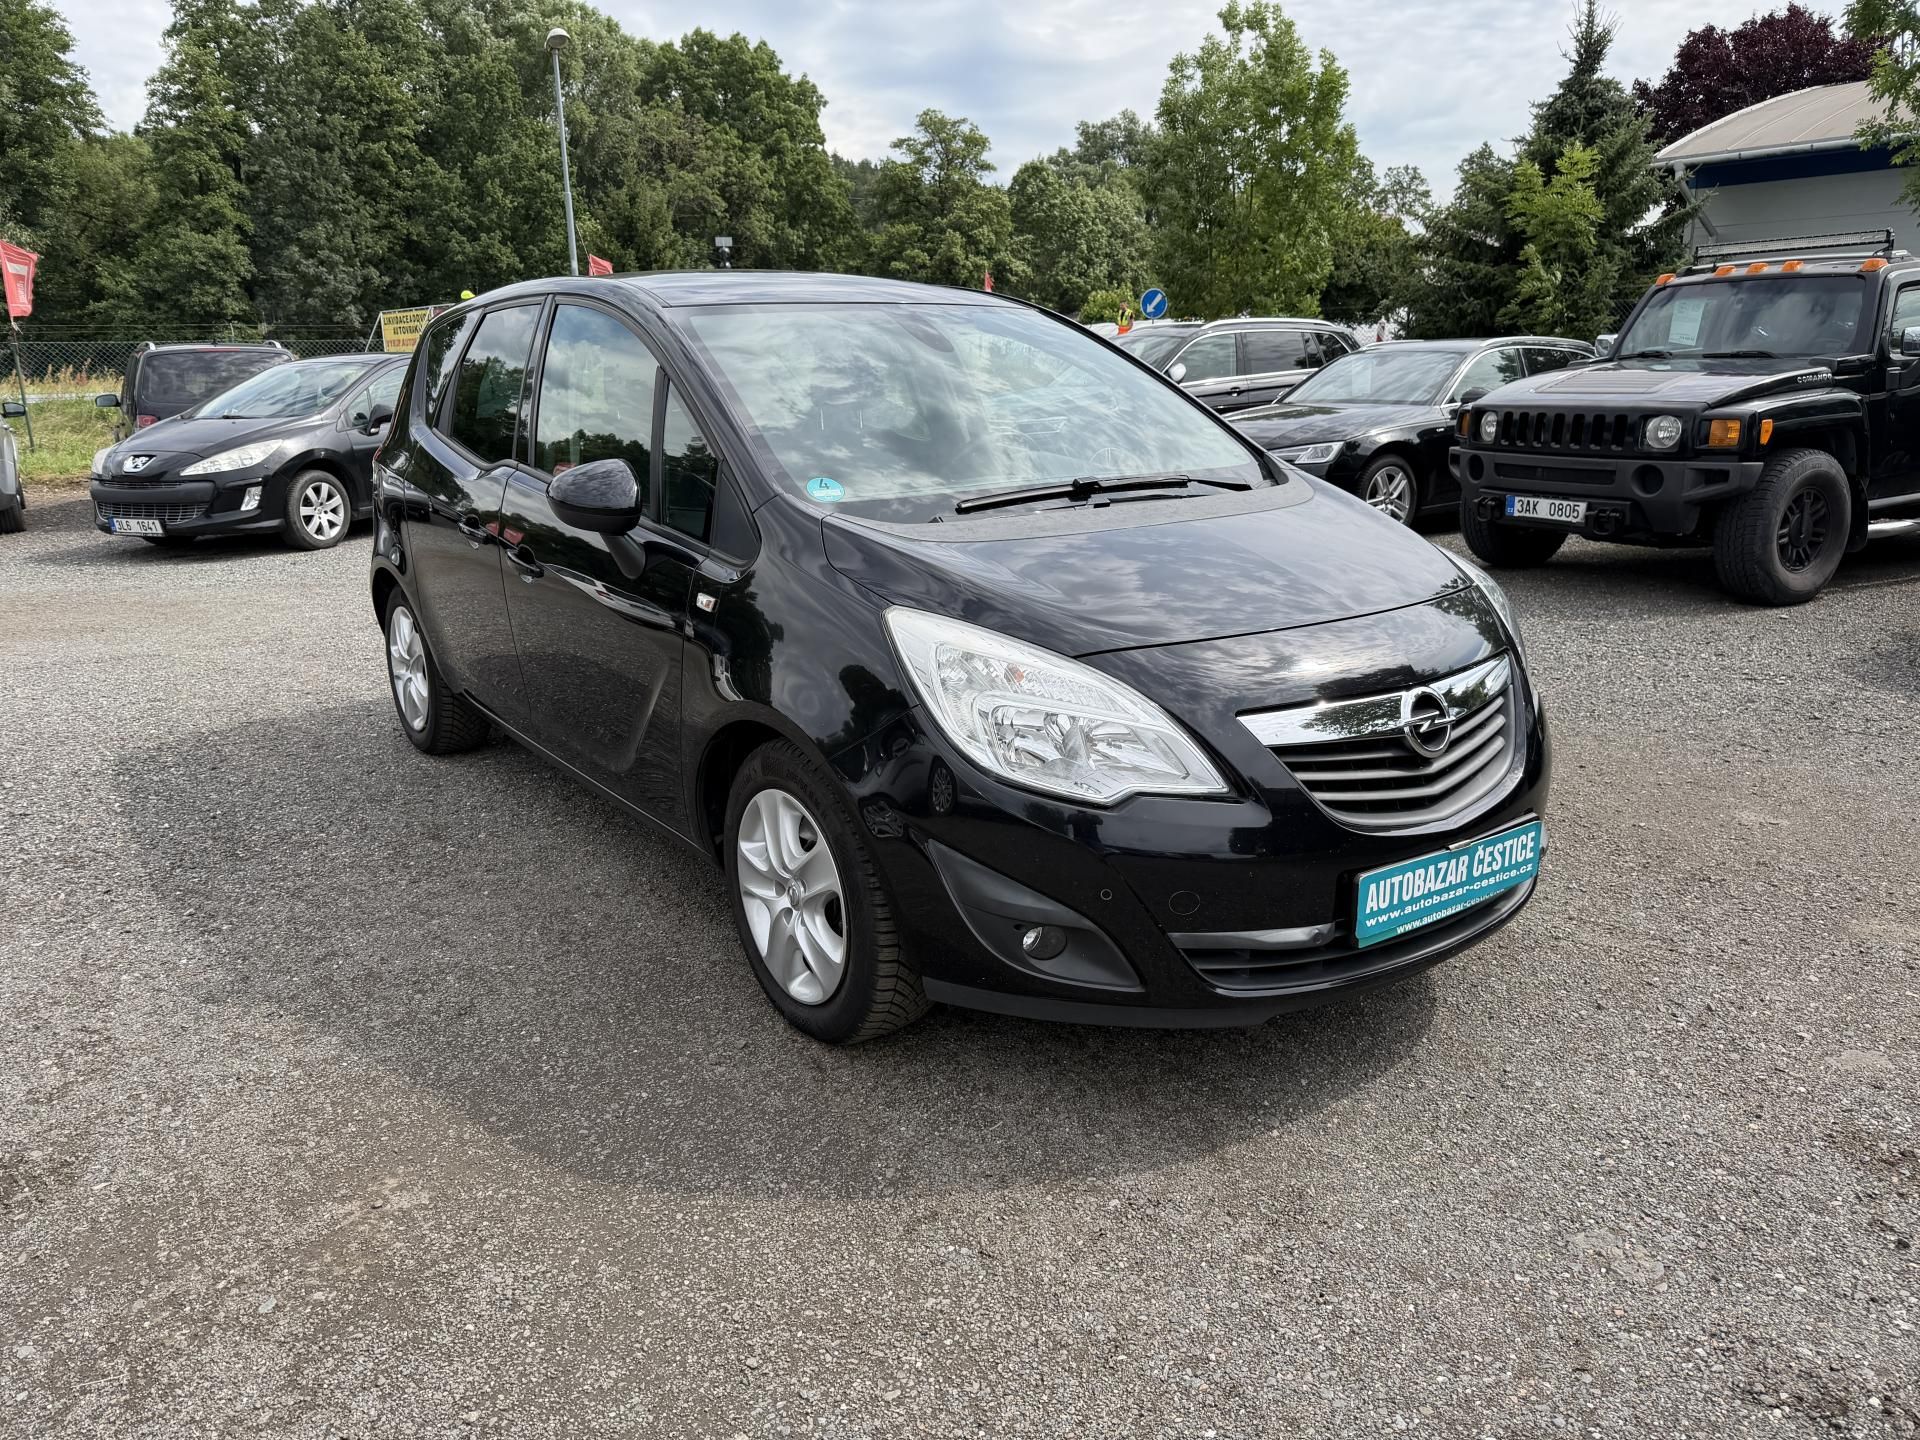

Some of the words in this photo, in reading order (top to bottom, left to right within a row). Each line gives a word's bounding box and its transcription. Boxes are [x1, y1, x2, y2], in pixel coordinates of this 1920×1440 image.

[819, 479, 829, 489] 4
[1517, 499, 1539, 515] 3AK
[1549, 502, 1580, 518] 0805
[116, 519, 131, 530] 3L6
[137, 521, 157, 532] 1641
[1365, 855, 1469, 914] AUTOBAZAR
[1473, 832, 1536, 878] ČESTICE
[1365, 864, 1532, 927] www.autobazar-cestice.cz
